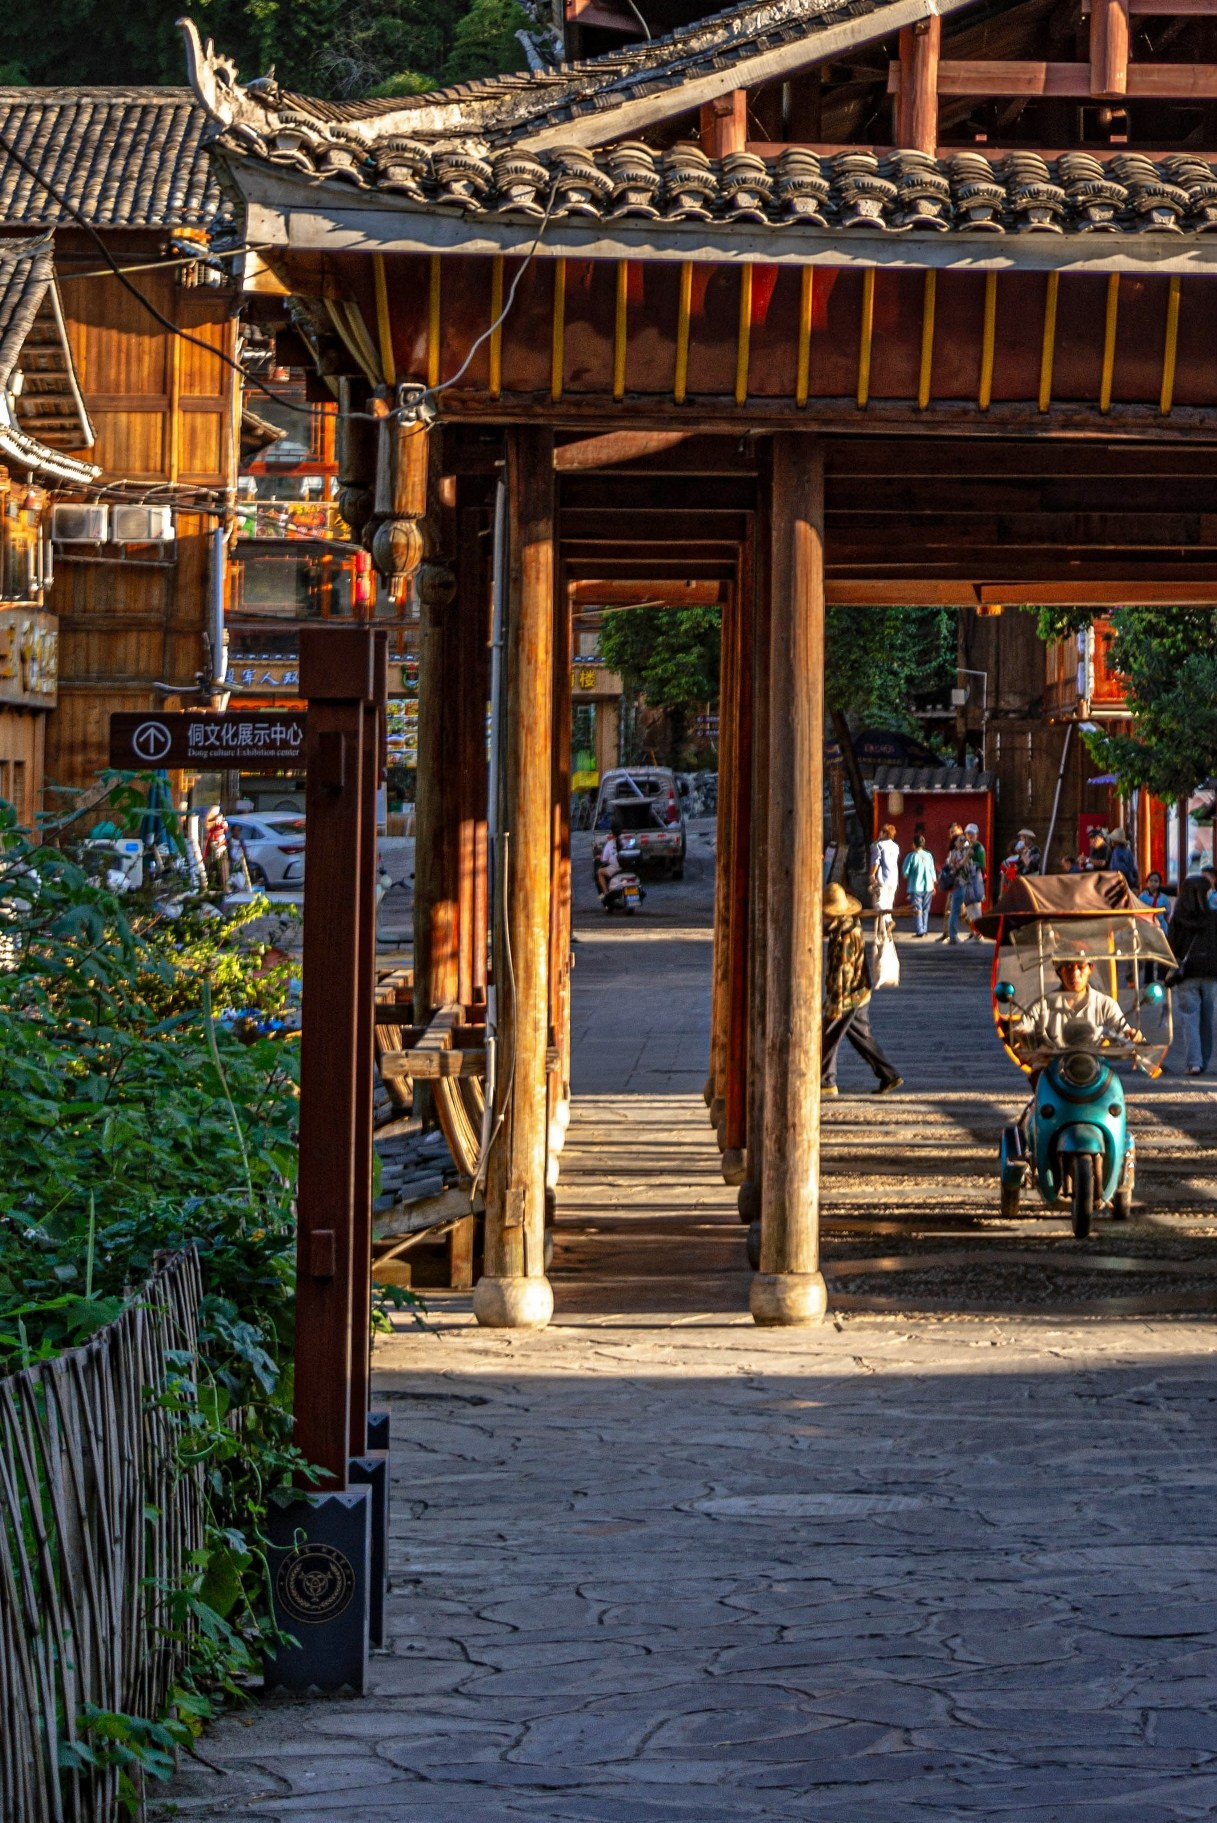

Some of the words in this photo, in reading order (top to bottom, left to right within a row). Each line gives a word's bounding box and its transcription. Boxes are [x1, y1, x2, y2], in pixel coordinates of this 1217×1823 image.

[188, 722, 303, 746] 侗文化展示中心
[188, 748, 209, 758] Dong
[276, 749, 300, 757] center
